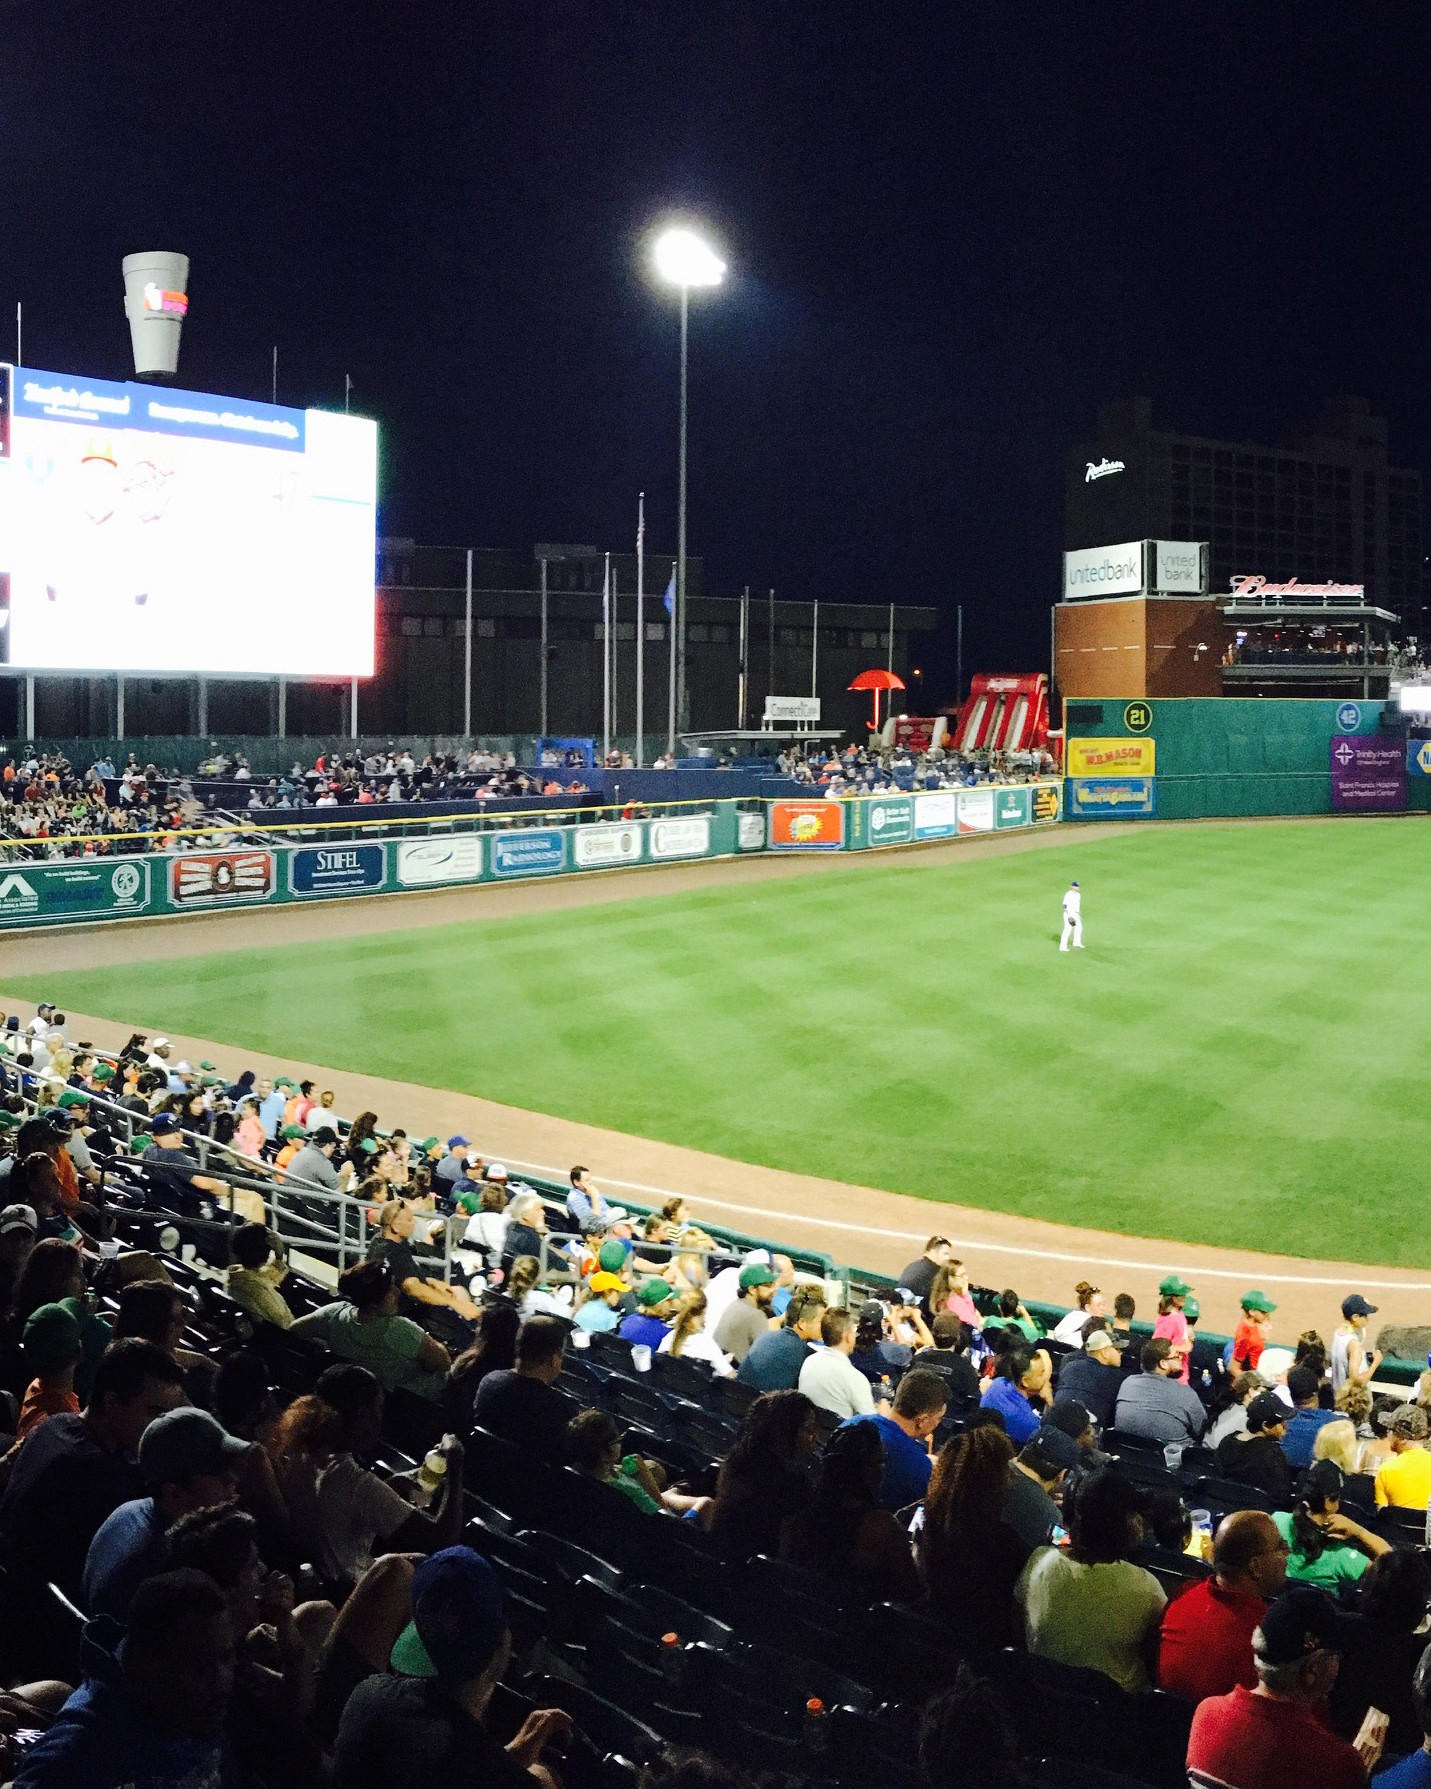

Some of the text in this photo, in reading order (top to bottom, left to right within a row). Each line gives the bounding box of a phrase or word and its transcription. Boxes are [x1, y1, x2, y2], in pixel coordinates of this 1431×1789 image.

[1164, 568, 1193, 581] bank
[1229, 575, 1364, 598] Budweiser
[1130, 710, 1146, 725] 21
[1340, 709, 1356, 725] 42
[316, 851, 361, 871] STIFEL
